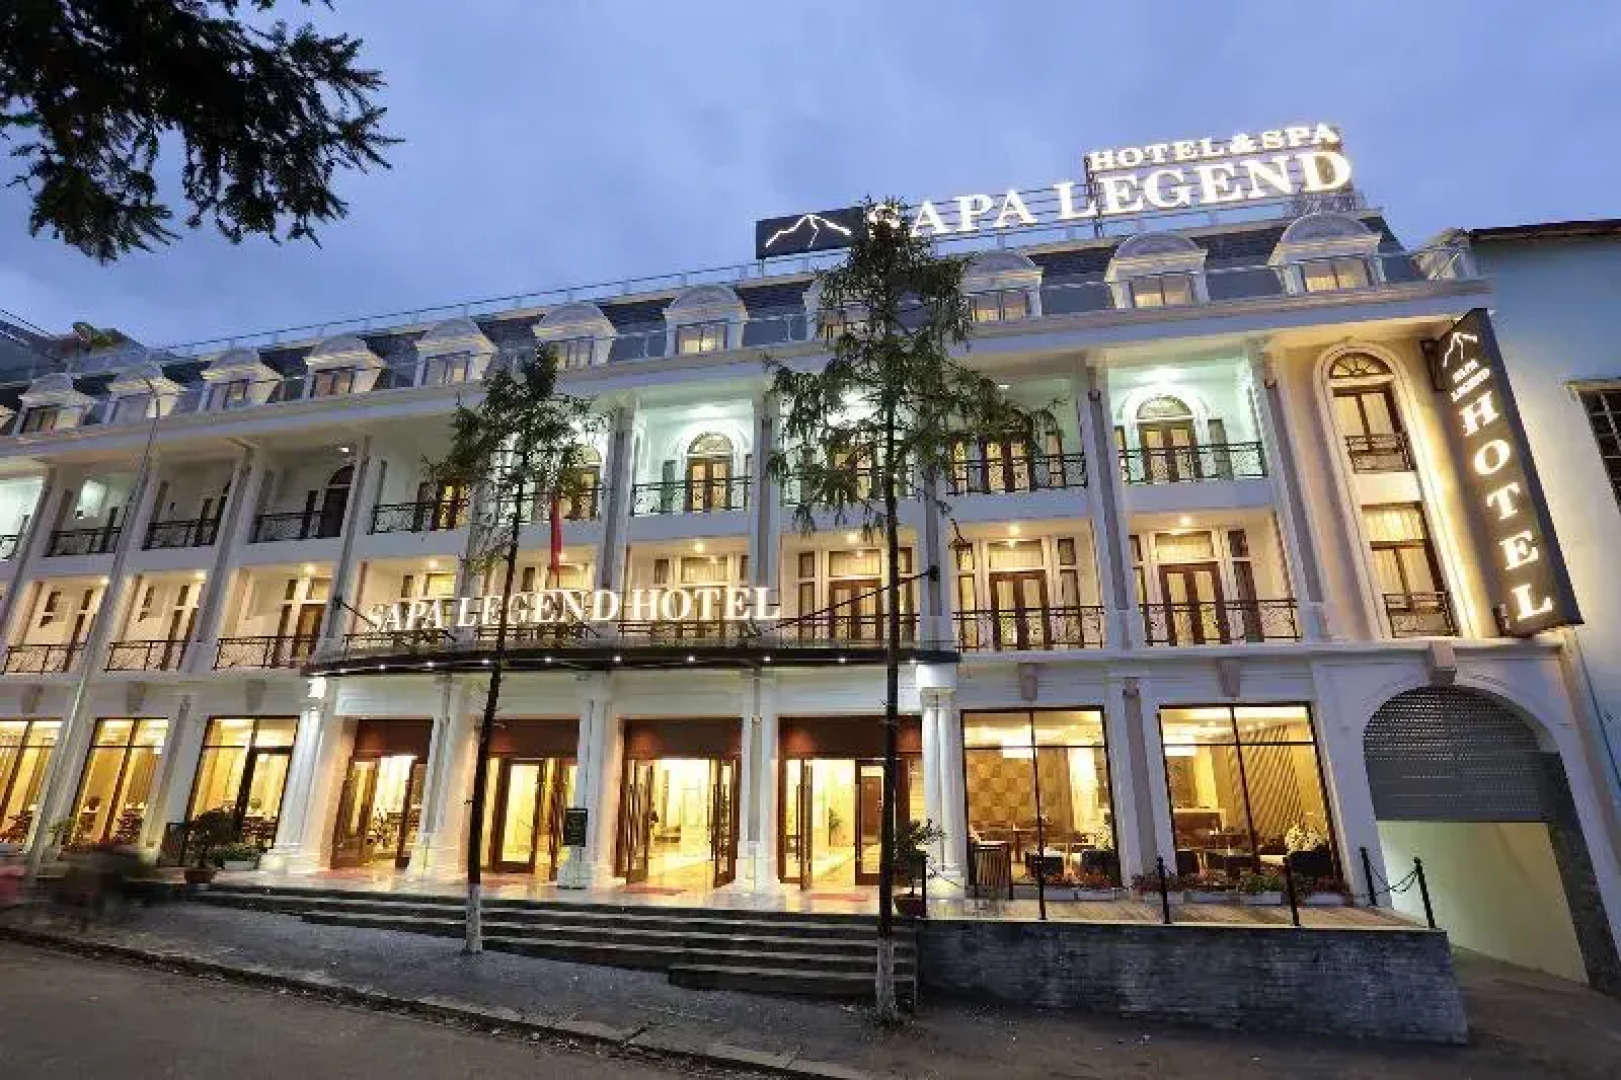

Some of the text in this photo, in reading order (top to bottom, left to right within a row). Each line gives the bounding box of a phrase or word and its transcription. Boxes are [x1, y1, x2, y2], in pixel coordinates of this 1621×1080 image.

[1054, 150, 1352, 218] LEGEND
[1459, 391, 1553, 621] HOTEL
[365, 585, 781, 632] SAPA LEGEND HOTEL
